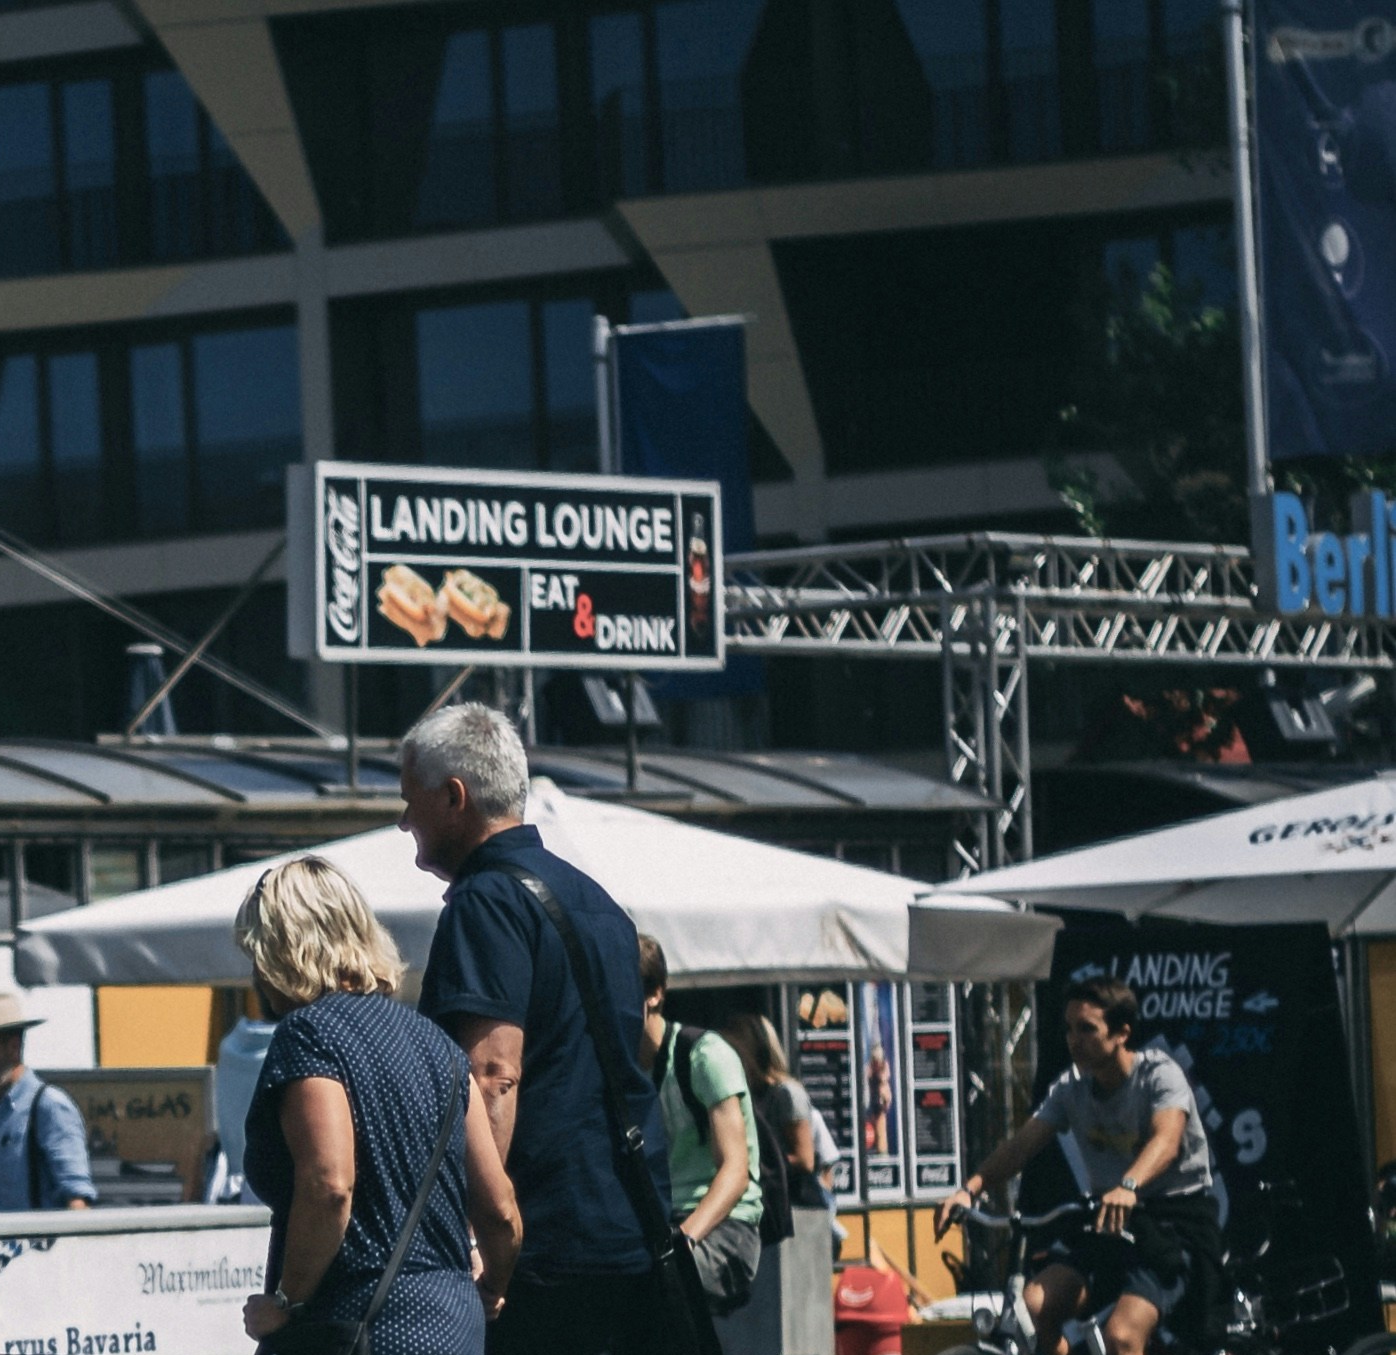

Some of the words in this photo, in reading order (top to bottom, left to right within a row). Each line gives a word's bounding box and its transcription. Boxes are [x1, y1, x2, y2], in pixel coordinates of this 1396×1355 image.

[369, 494, 528, 547] LANDING
[535, 501, 674, 553] LOUNGE
[530, 573, 580, 611] EAT
[572, 592, 596, 640] &
[594, 615, 677, 652] DRINK
[1137, 988, 1234, 1019] OUNGE
